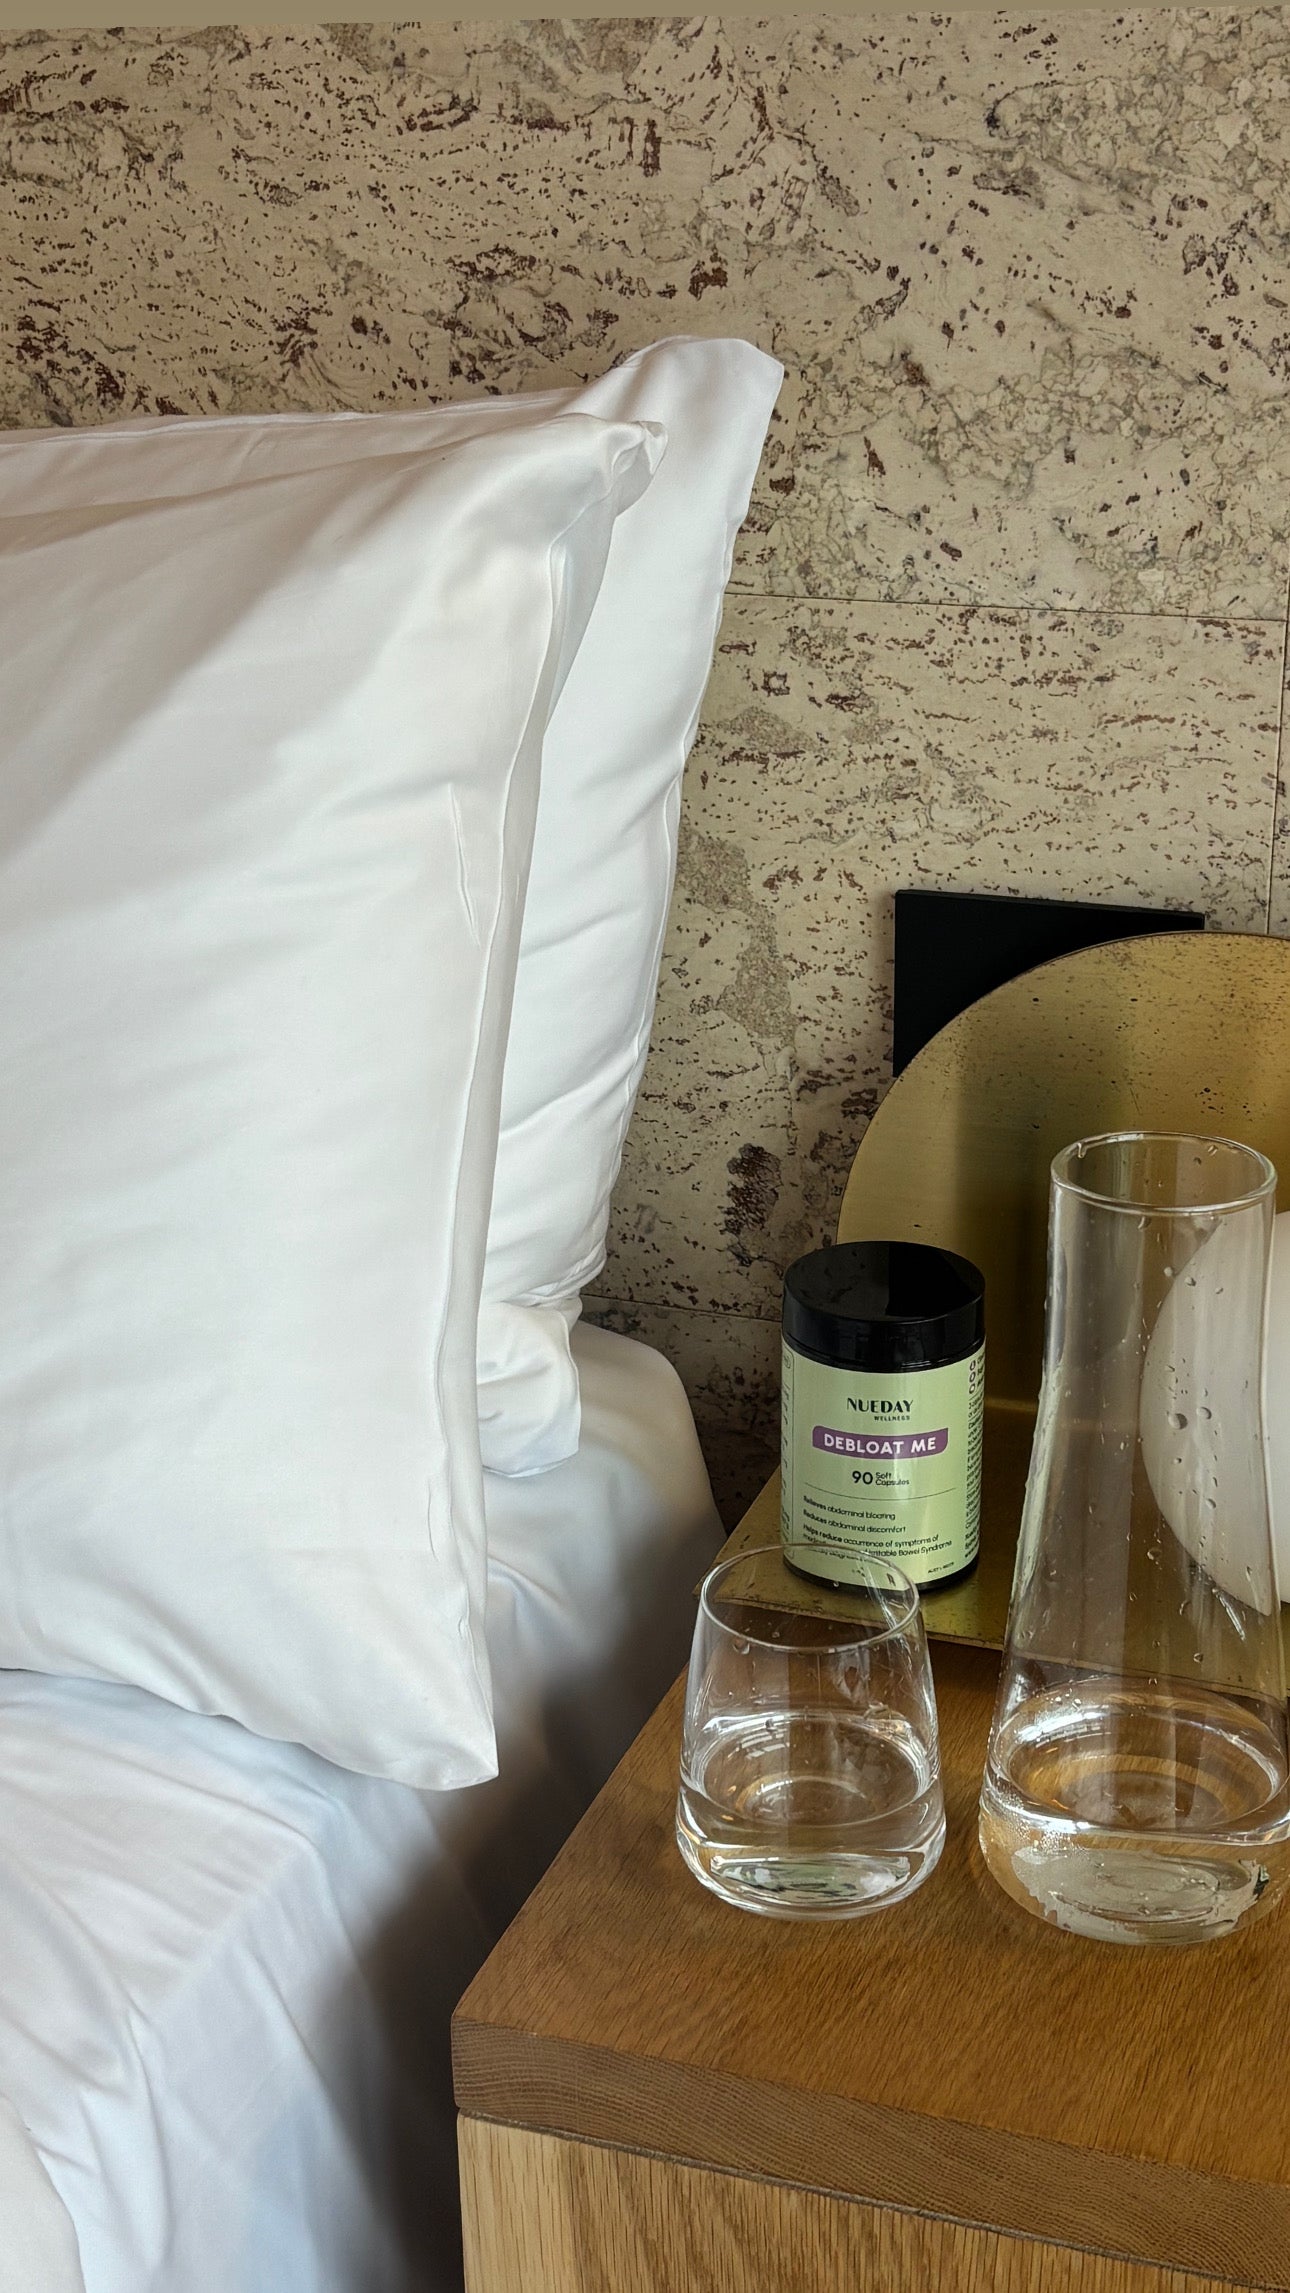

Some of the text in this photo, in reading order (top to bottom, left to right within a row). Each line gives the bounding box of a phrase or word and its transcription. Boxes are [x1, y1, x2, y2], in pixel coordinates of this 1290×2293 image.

[847, 1397, 914, 1414] NUEDAY
[824, 1433, 937, 1455] DEBLOAT ME
[852, 1470, 892, 1485] 90 Soft
[875, 1478, 911, 1488] Capsules
[827, 1506, 864, 1519] abdominal
[865, 1511, 896, 1521] bloating
[828, 1519, 865, 1532] abdominal
[866, 1525, 906, 1534] discomfort
[819, 1530, 843, 1543] reduce
[843, 1537, 884, 1548] occurrence
[885, 1539, 893, 1548] of
[894, 1536, 931, 1549] symptoms
[932, 1533, 939, 1542] of
[899, 1547, 920, 1557] Bowel
[920, 1540, 953, 1555] Syndrome
